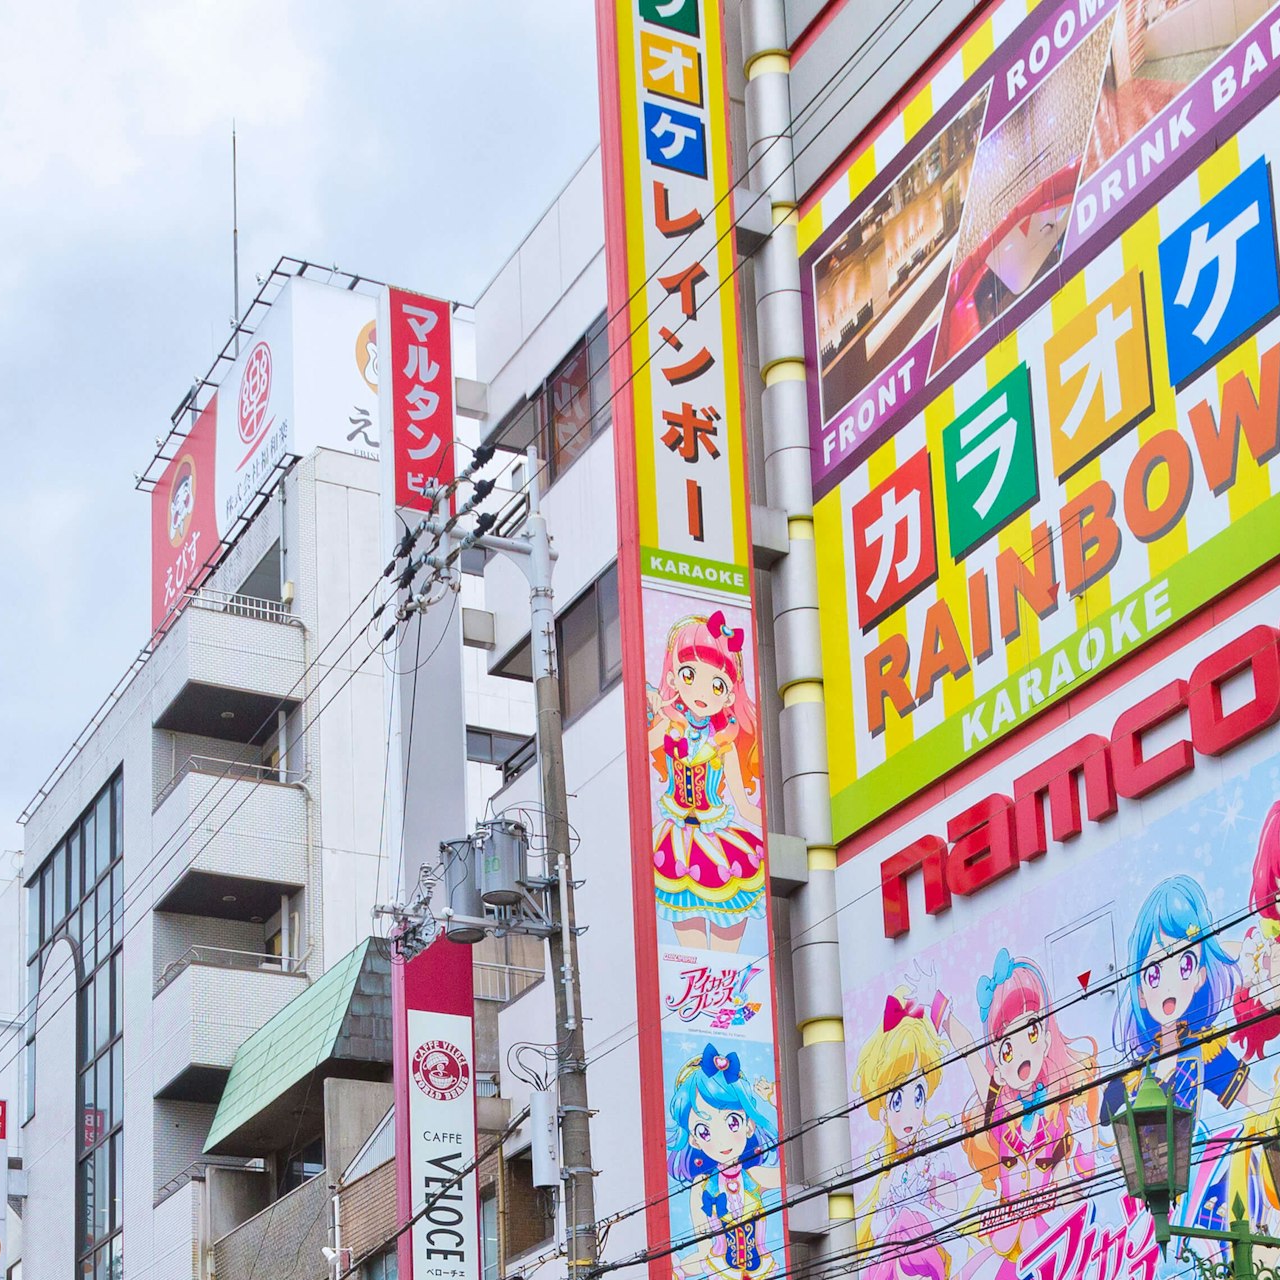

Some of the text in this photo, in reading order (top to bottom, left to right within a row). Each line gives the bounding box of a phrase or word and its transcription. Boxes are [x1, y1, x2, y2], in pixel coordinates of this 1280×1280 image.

[1075, 102, 1196, 239] DRINK
[401, 302, 442, 460] マルタン
[652, 181, 723, 545] レインボー
[822, 356, 917, 468] FRONT
[860, 198, 1265, 608] カラオケ
[650, 556, 745, 589] KARAOKE
[962, 578, 1173, 753] KARAOKE
[413, 1072, 469, 1101] WORLD BEANS
[425, 1152, 465, 1263] VELOCE
